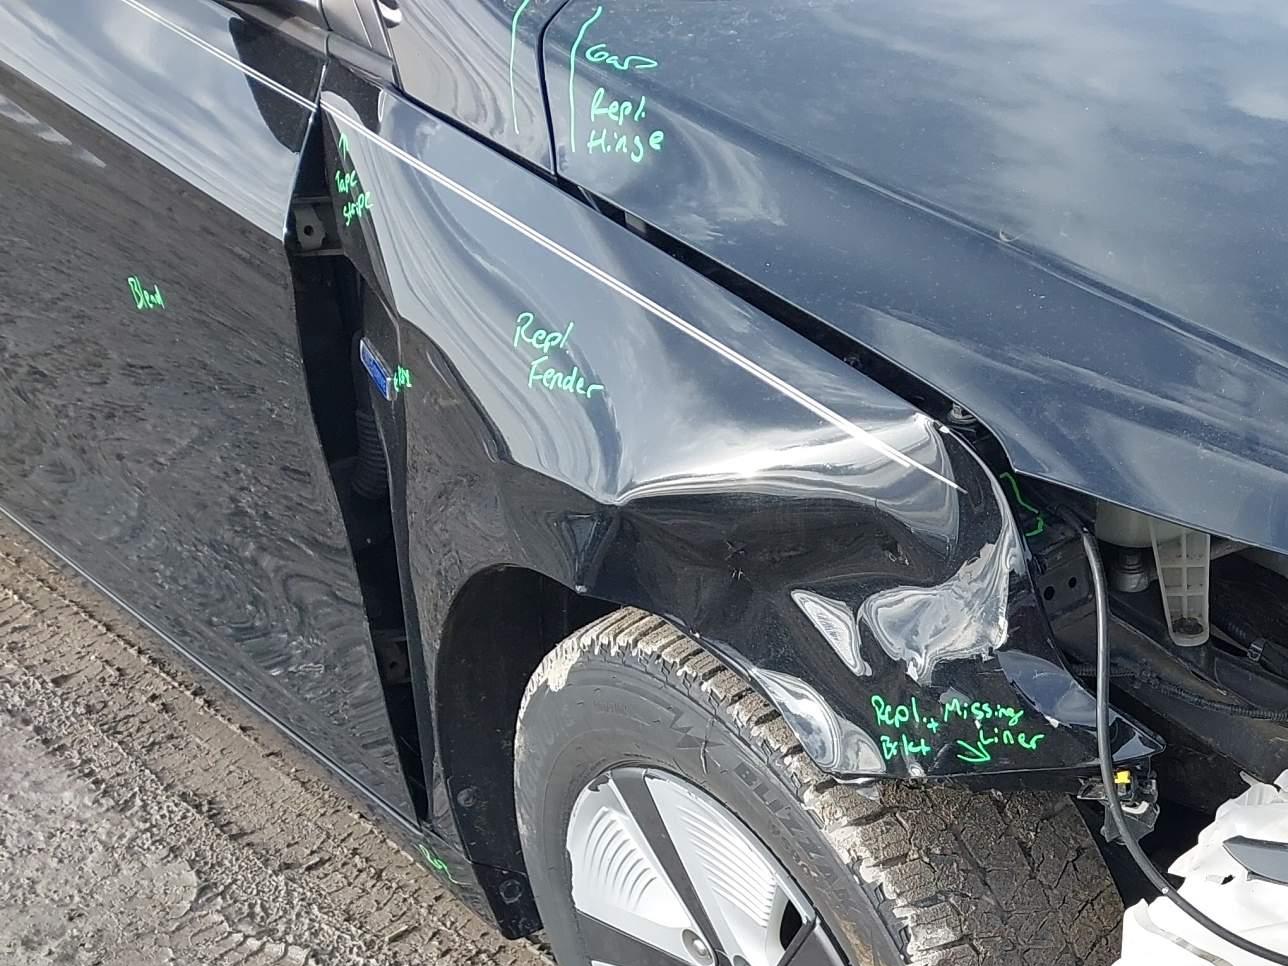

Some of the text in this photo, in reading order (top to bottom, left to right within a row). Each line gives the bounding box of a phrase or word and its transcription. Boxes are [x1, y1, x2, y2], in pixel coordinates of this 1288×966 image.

[587, 128, 664, 163] Hinge
[528, 355, 604, 398] Fender
[943, 698, 1024, 726] Missing
[979, 727, 1045, 750] Liner
